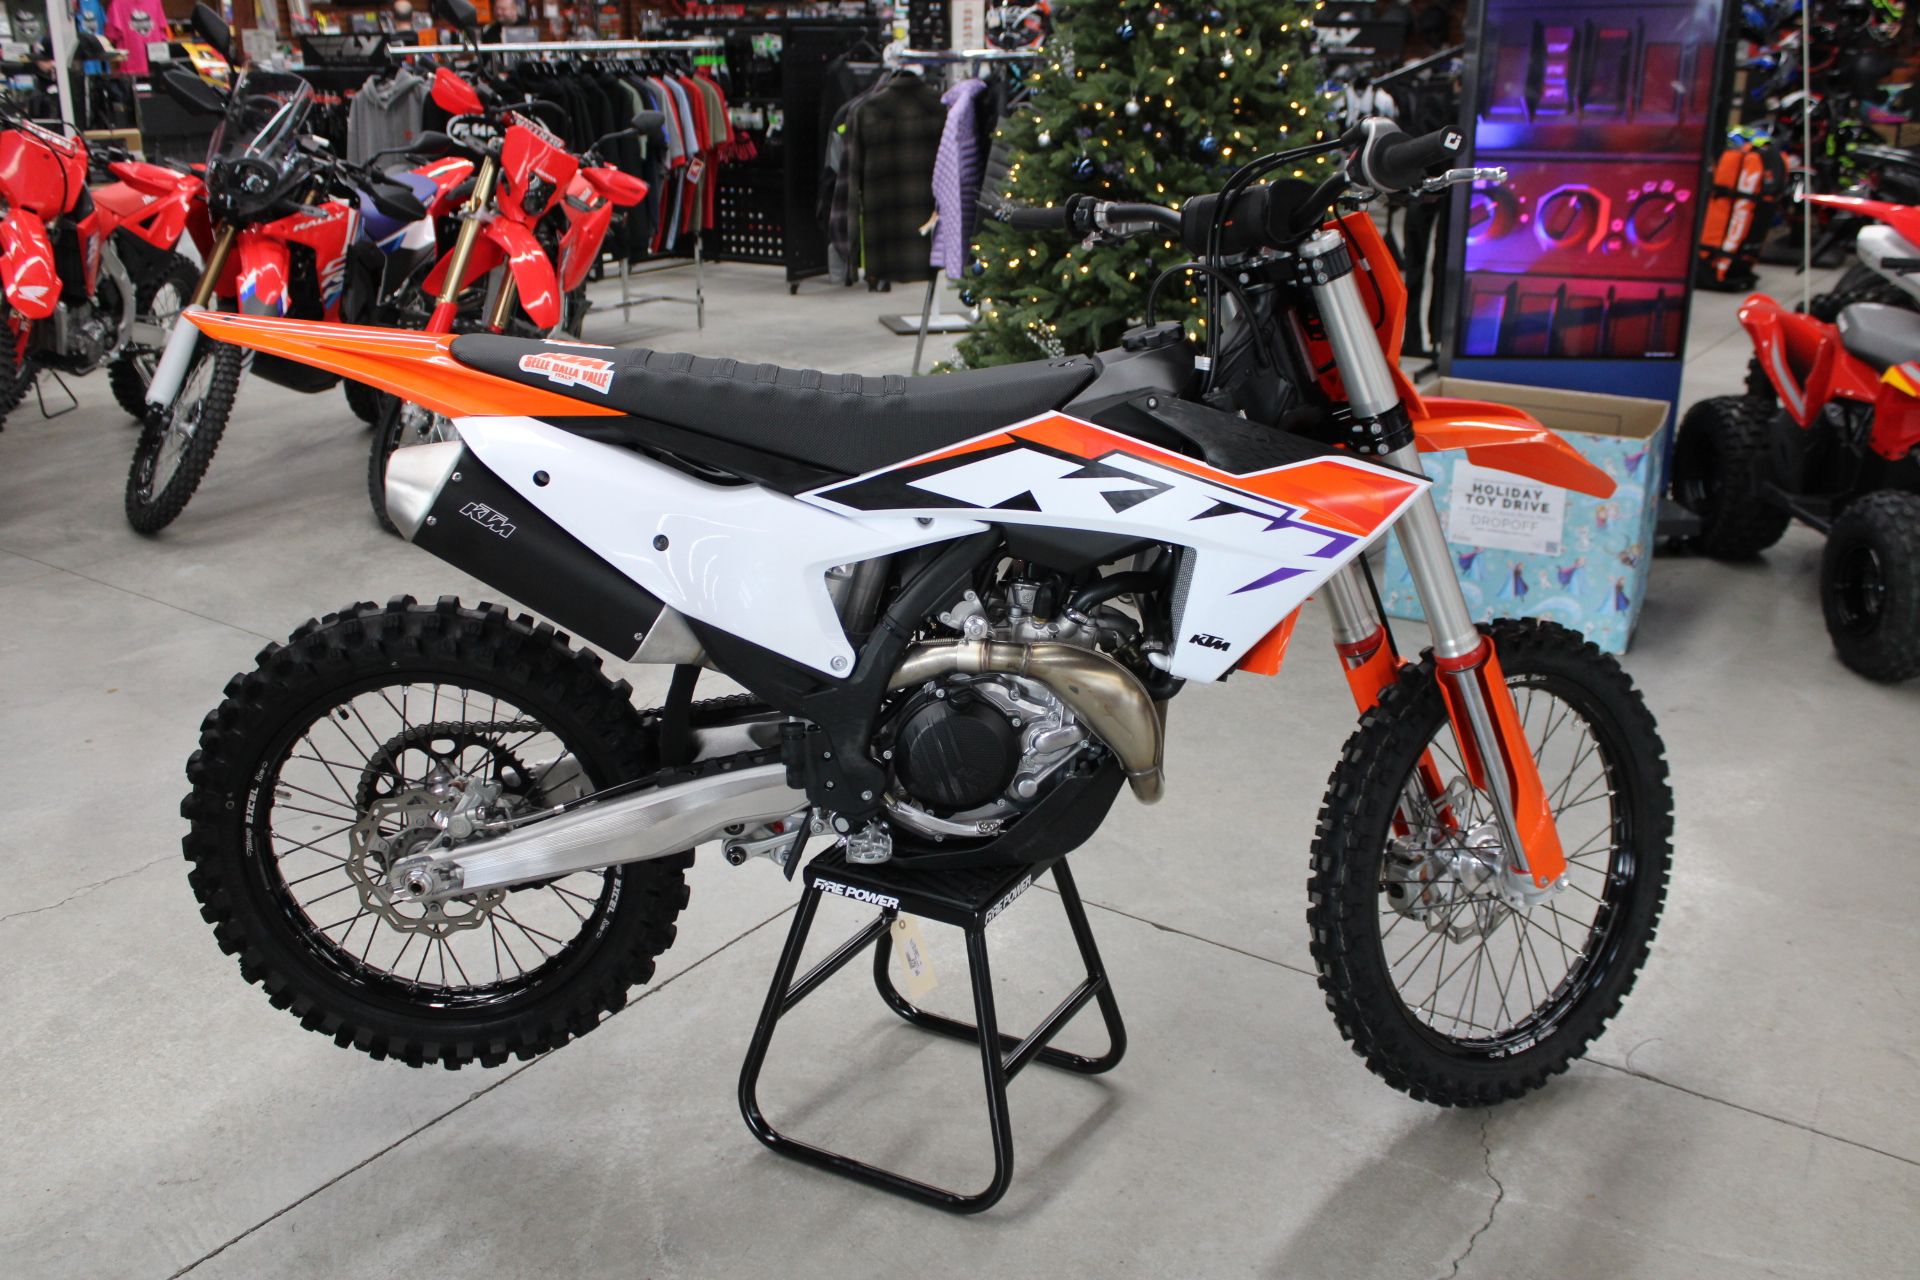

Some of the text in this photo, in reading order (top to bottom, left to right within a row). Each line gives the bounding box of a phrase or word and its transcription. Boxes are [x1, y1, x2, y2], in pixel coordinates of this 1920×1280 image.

[552, 363, 579, 378] DALLA
[582, 370, 609, 388] VALLE
[555, 373, 572, 381] ITALY
[1465, 494, 1550, 513] TOY DRIVE
[1472, 484, 1543, 499] HOLIDAY
[459, 502, 517, 538] KTM
[1471, 514, 1538, 531] DROPOFF
[1188, 633, 1231, 651] KTM
[245, 787, 259, 824] EXCEL
[606, 878, 621, 913] EXCEL
[813, 878, 899, 909] FIRE POWER
[985, 874, 1031, 925] FIRE POWER
